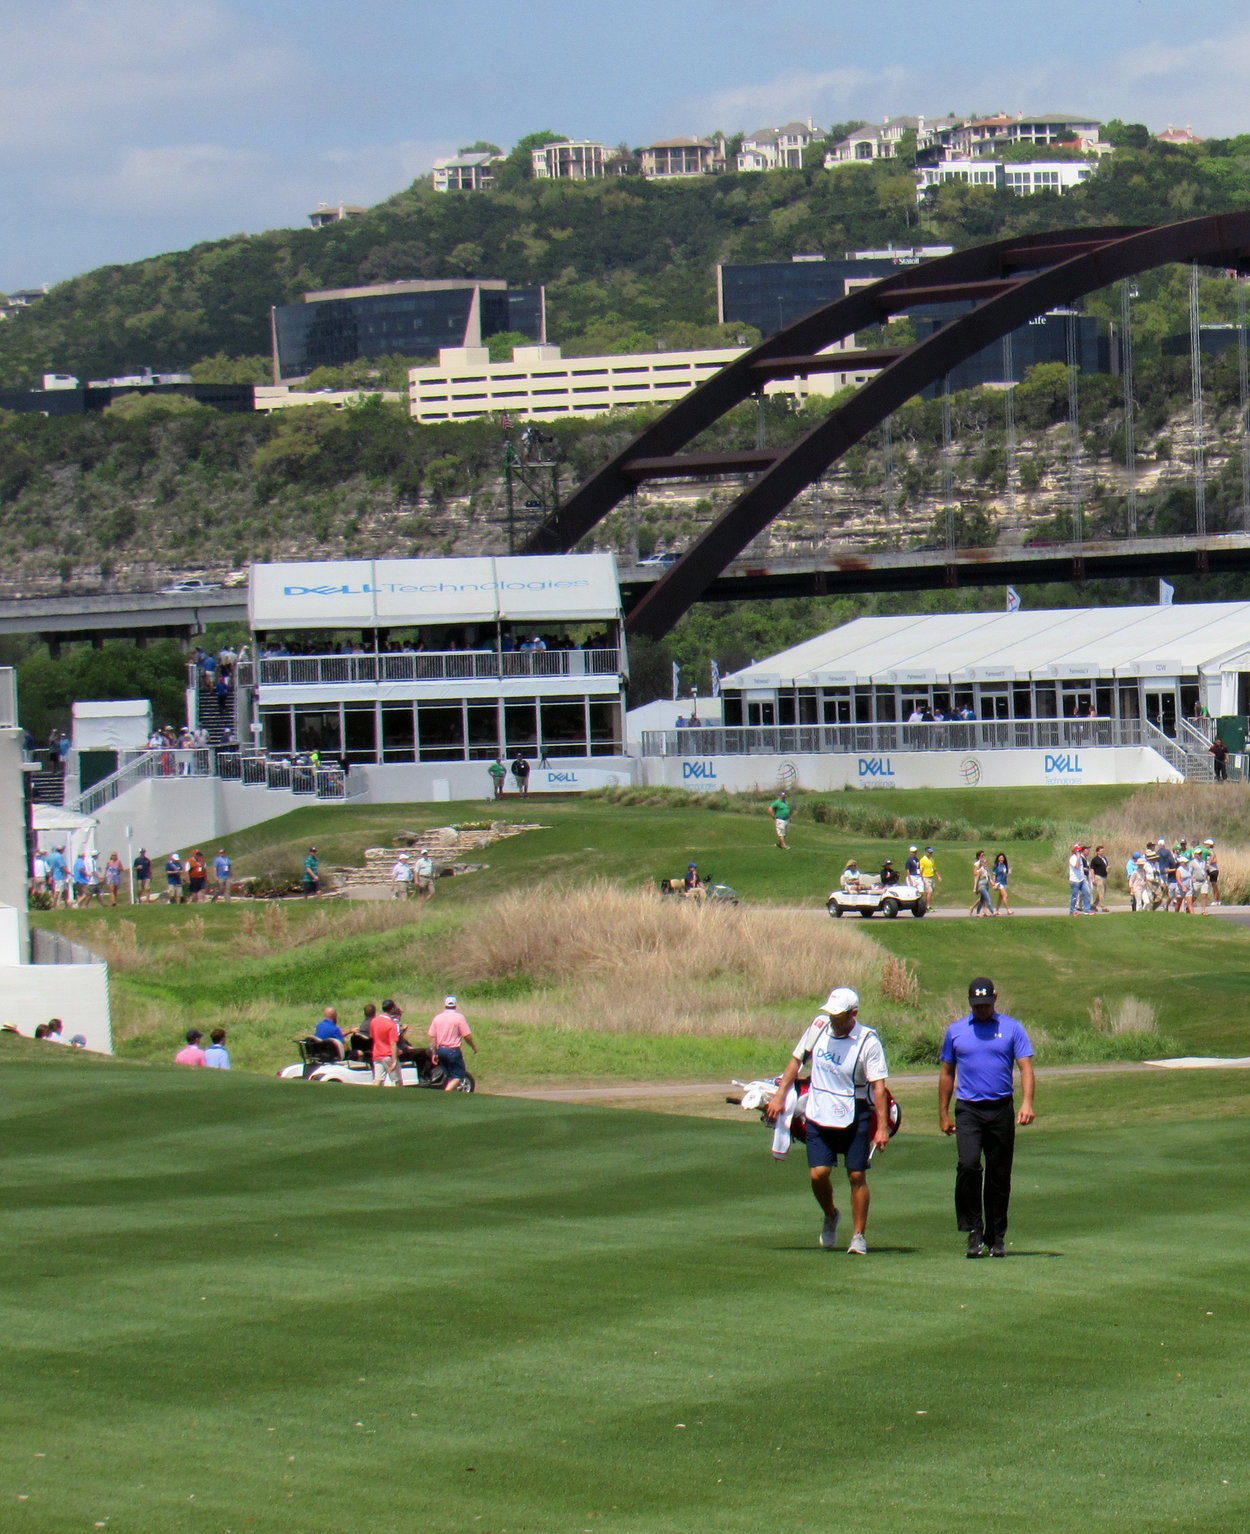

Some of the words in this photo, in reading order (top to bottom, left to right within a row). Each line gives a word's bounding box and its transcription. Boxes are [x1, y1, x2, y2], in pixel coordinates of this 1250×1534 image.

[899, 257, 920, 265] Statoil
[283, 583, 382, 596] DELL
[382, 578, 590, 593] Technologies
[682, 761, 717, 778] DELL
[858, 758, 895, 776] DELL
[1045, 754, 1082, 773] DELL
[548, 773, 578, 782] DELL
[817, 1048, 842, 1066] DELL
